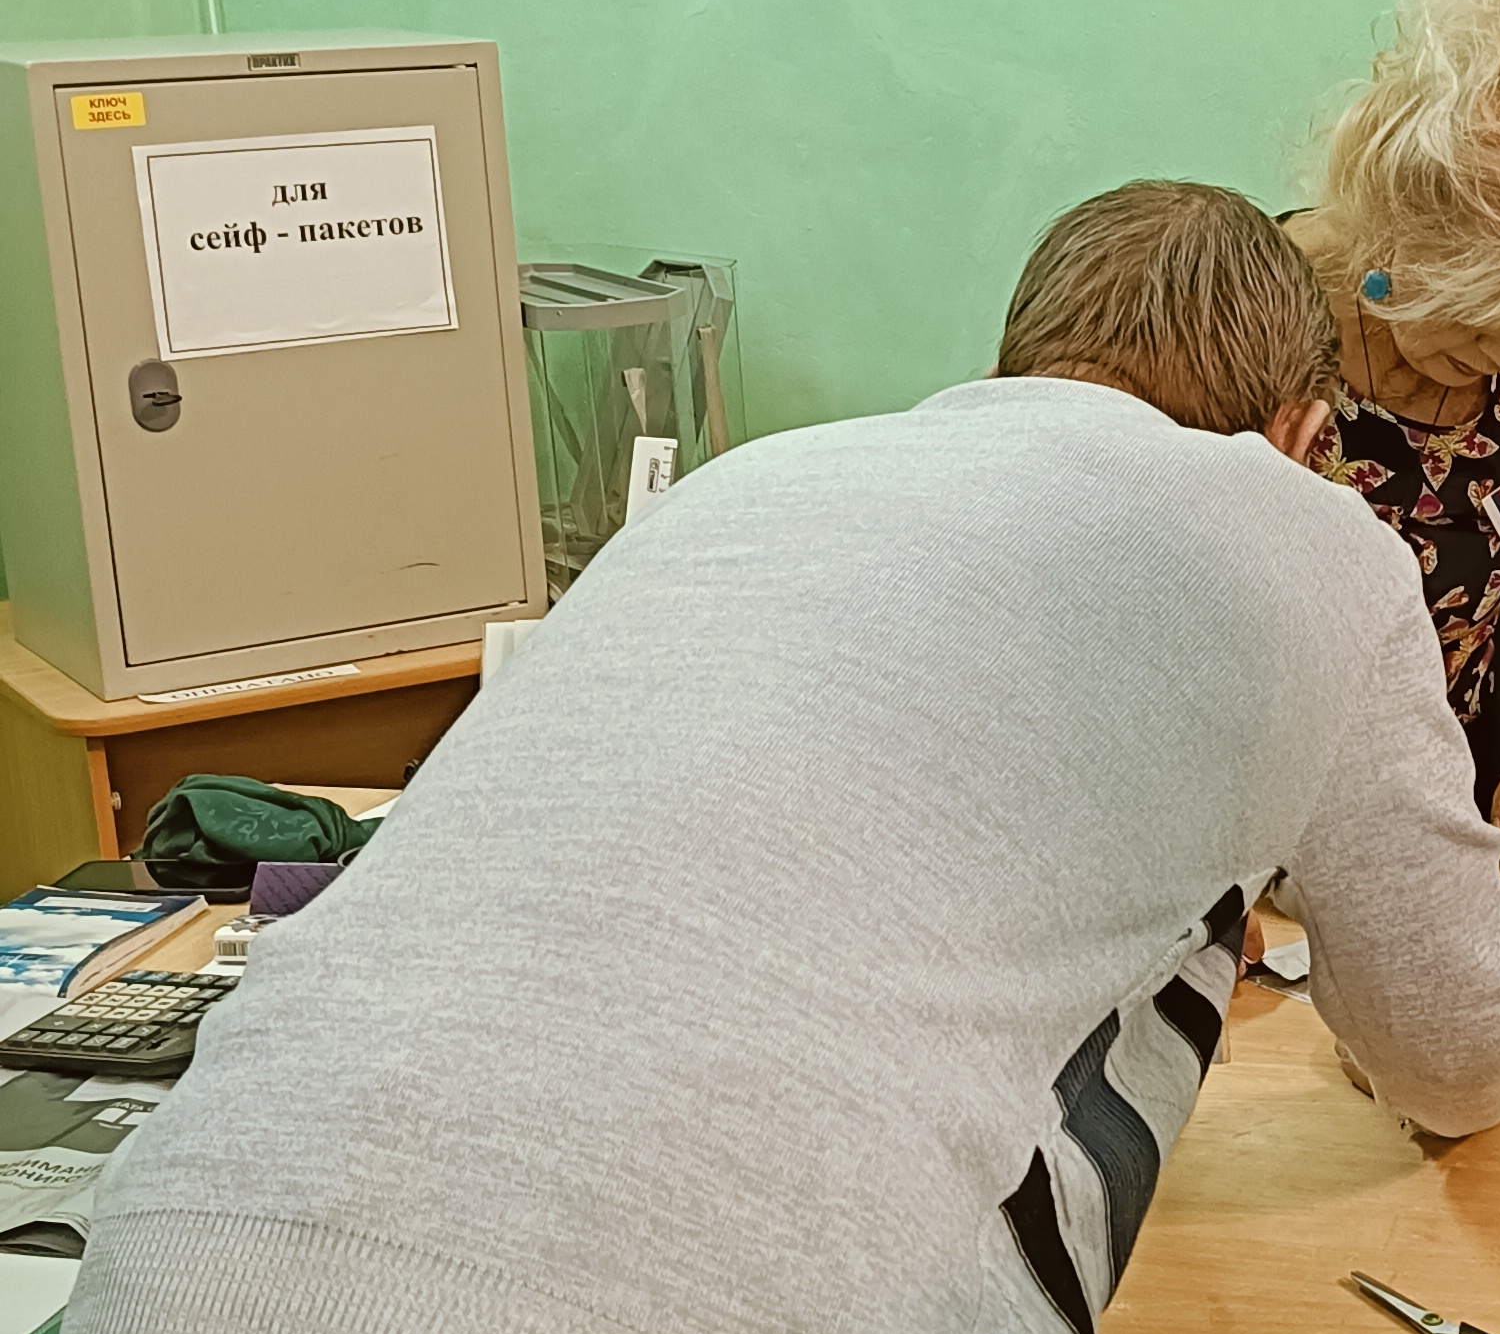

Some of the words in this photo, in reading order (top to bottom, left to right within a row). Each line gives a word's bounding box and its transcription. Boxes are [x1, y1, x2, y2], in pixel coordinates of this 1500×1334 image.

[89, 97, 127, 109] КЛЮЧ
[88, 111, 131, 123] ЗДЕСЬ
[271, 182, 328, 207] для
[190, 221, 267, 254] сейф
[299, 216, 423, 243] пакетов
[171, 670, 334, 700] ОПЕЧАТАНО
